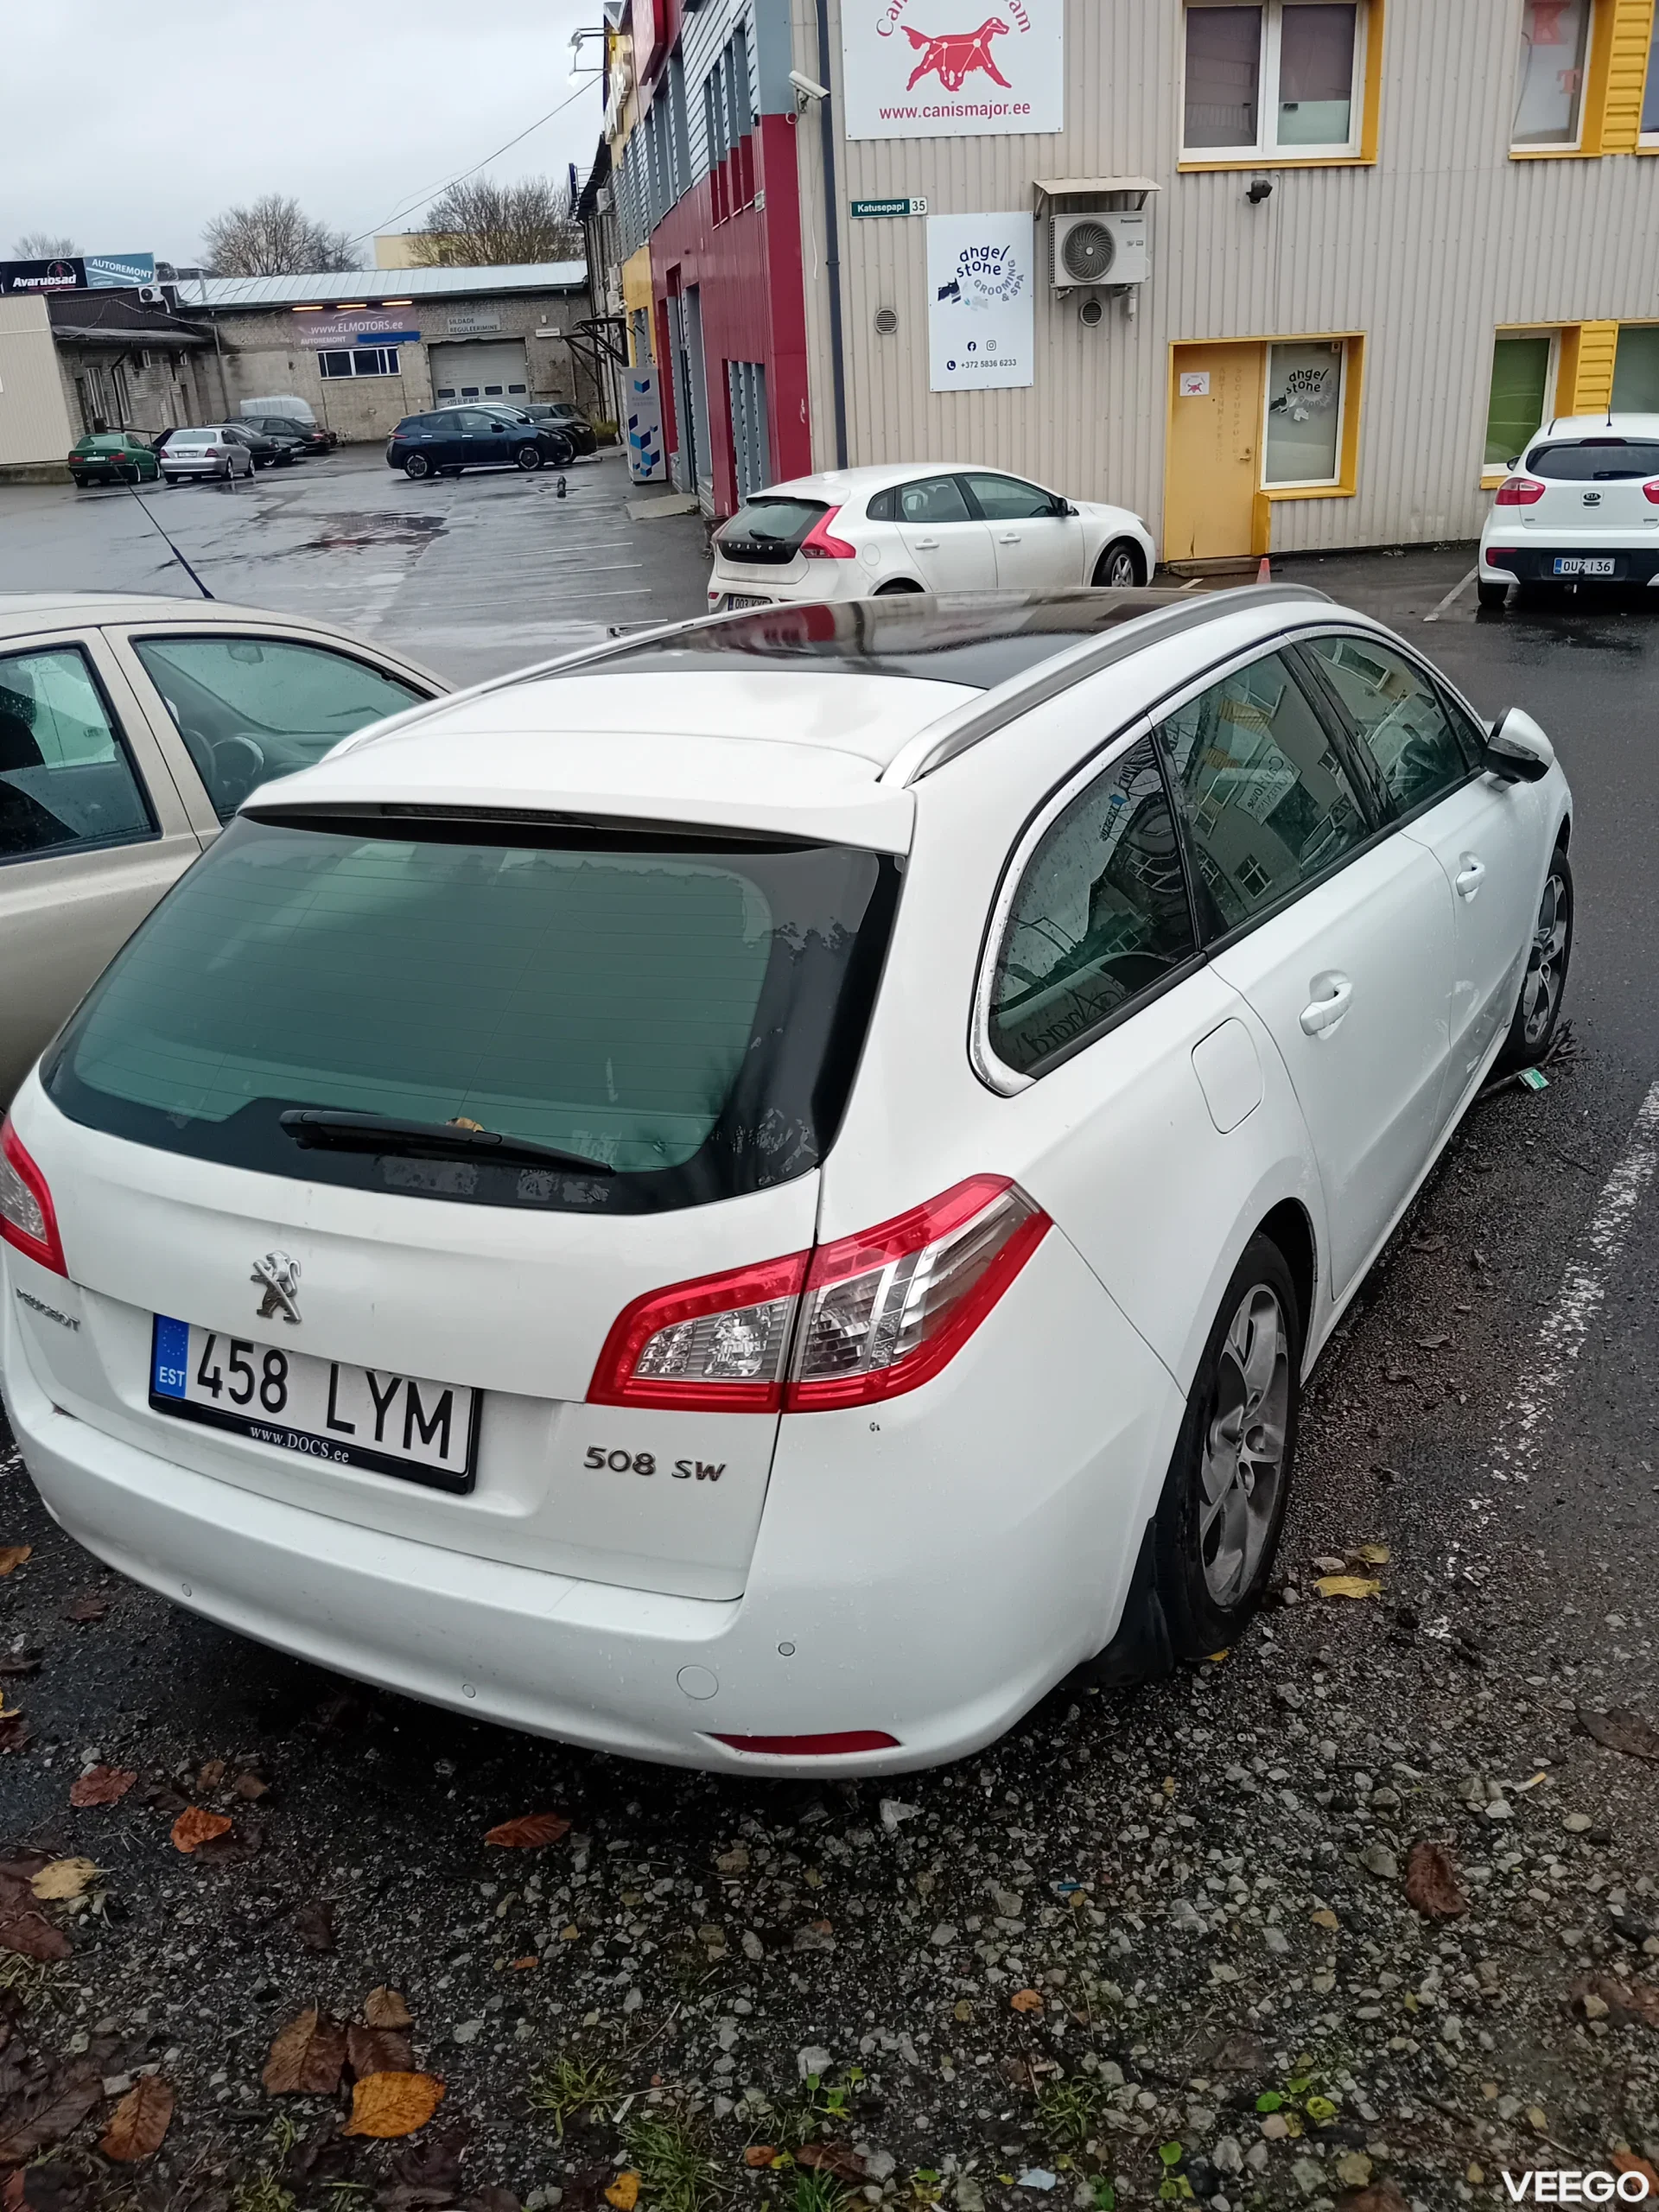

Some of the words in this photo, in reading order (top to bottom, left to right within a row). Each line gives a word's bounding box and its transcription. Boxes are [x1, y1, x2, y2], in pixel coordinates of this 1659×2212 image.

[879, 100, 1031, 119] www.canismajor.ee
[857, 201, 905, 213] Katusepapi
[912, 200, 925, 211] 35
[959, 245, 1010, 263] angel
[92, 258, 153, 279] AUTOREMONT
[957, 261, 1001, 277] stone
[12, 274, 77, 288] Avaruosad
[973, 259, 1016, 296] GROOMING
[1010, 274, 1024, 296] SPA
[310, 321, 404, 334] www.ELMOTORS.ee
[301, 336, 346, 345] AUTOREMONT
[1288, 368, 1330, 383] angel
[1286, 381, 1321, 394] stone
[728, 542, 774, 550] VOLVO
[159, 1365, 186, 1389] EST
[196, 1333, 289, 1414] 458
[326, 1362, 454, 1460] LYM
[249, 1425, 351, 1464] www.DOCS.ee
[582, 1445, 657, 1476] 508
[671, 1459, 727, 1482] SW
